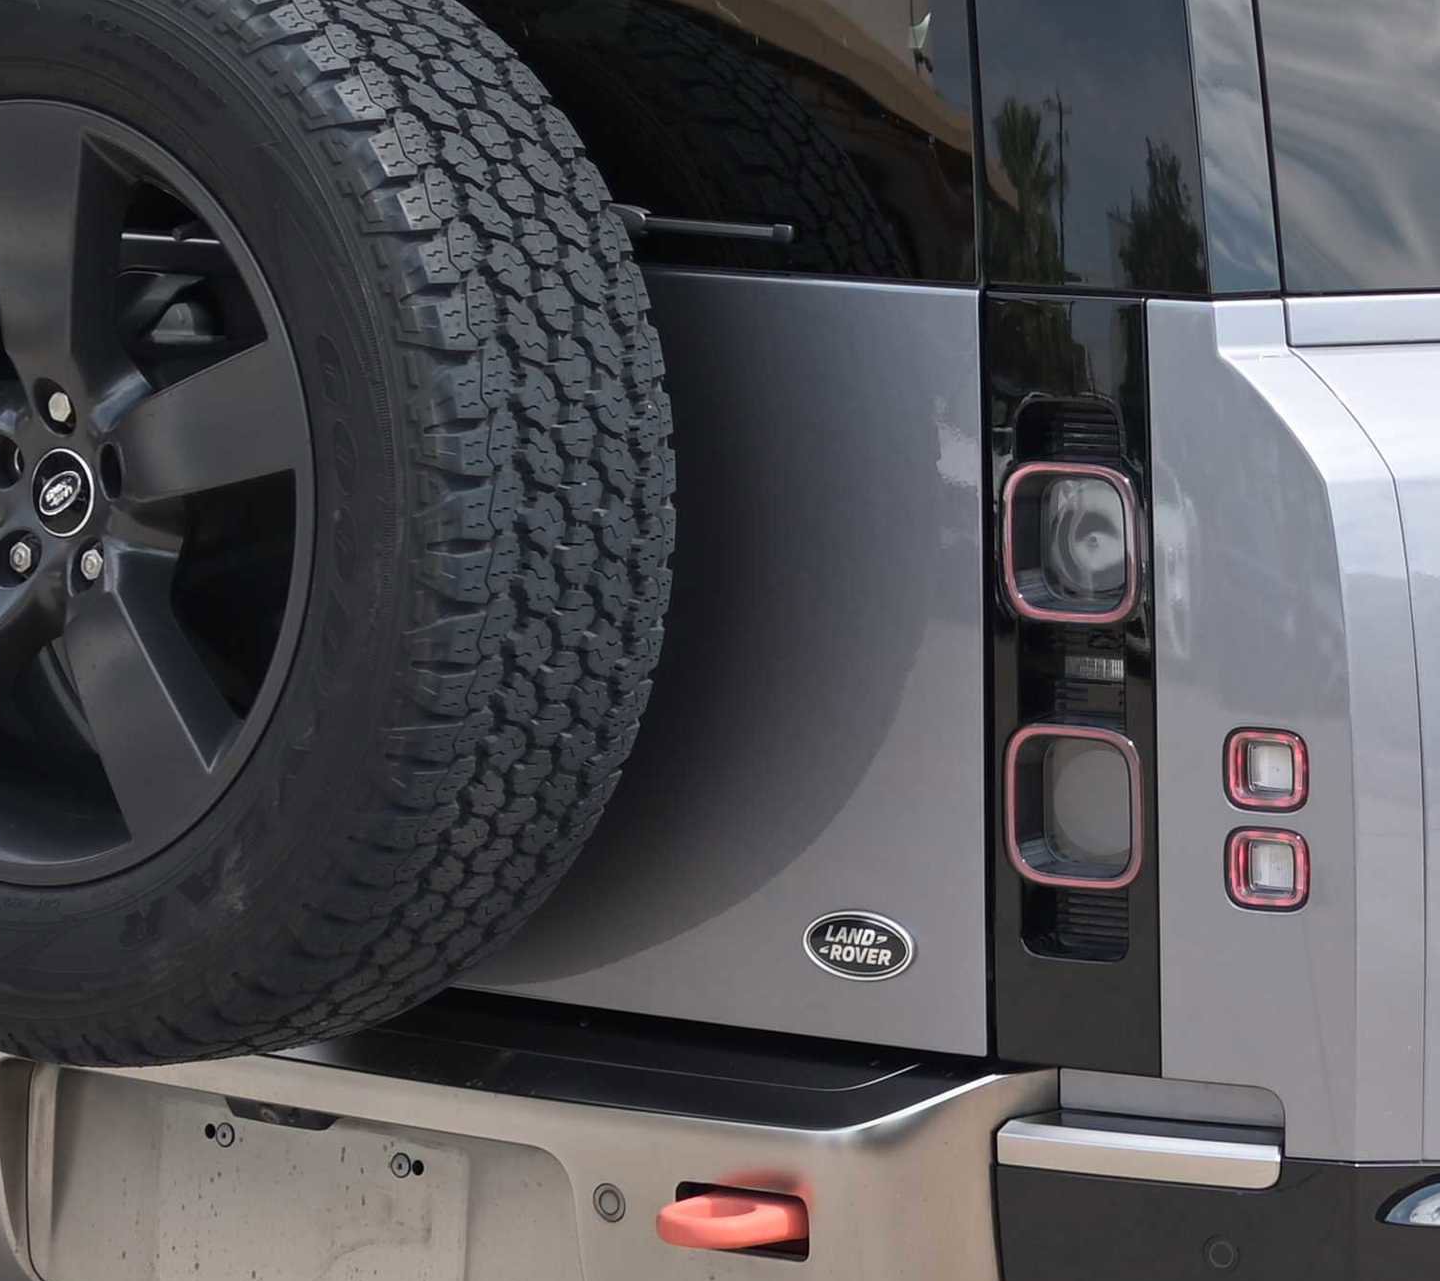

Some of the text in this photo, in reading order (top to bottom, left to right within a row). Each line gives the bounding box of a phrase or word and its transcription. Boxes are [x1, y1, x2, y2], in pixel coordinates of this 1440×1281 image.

[118, 332, 359, 946] GOODAR
[825, 924, 876, 946] LAND
[829, 944, 892, 966] ROVER
